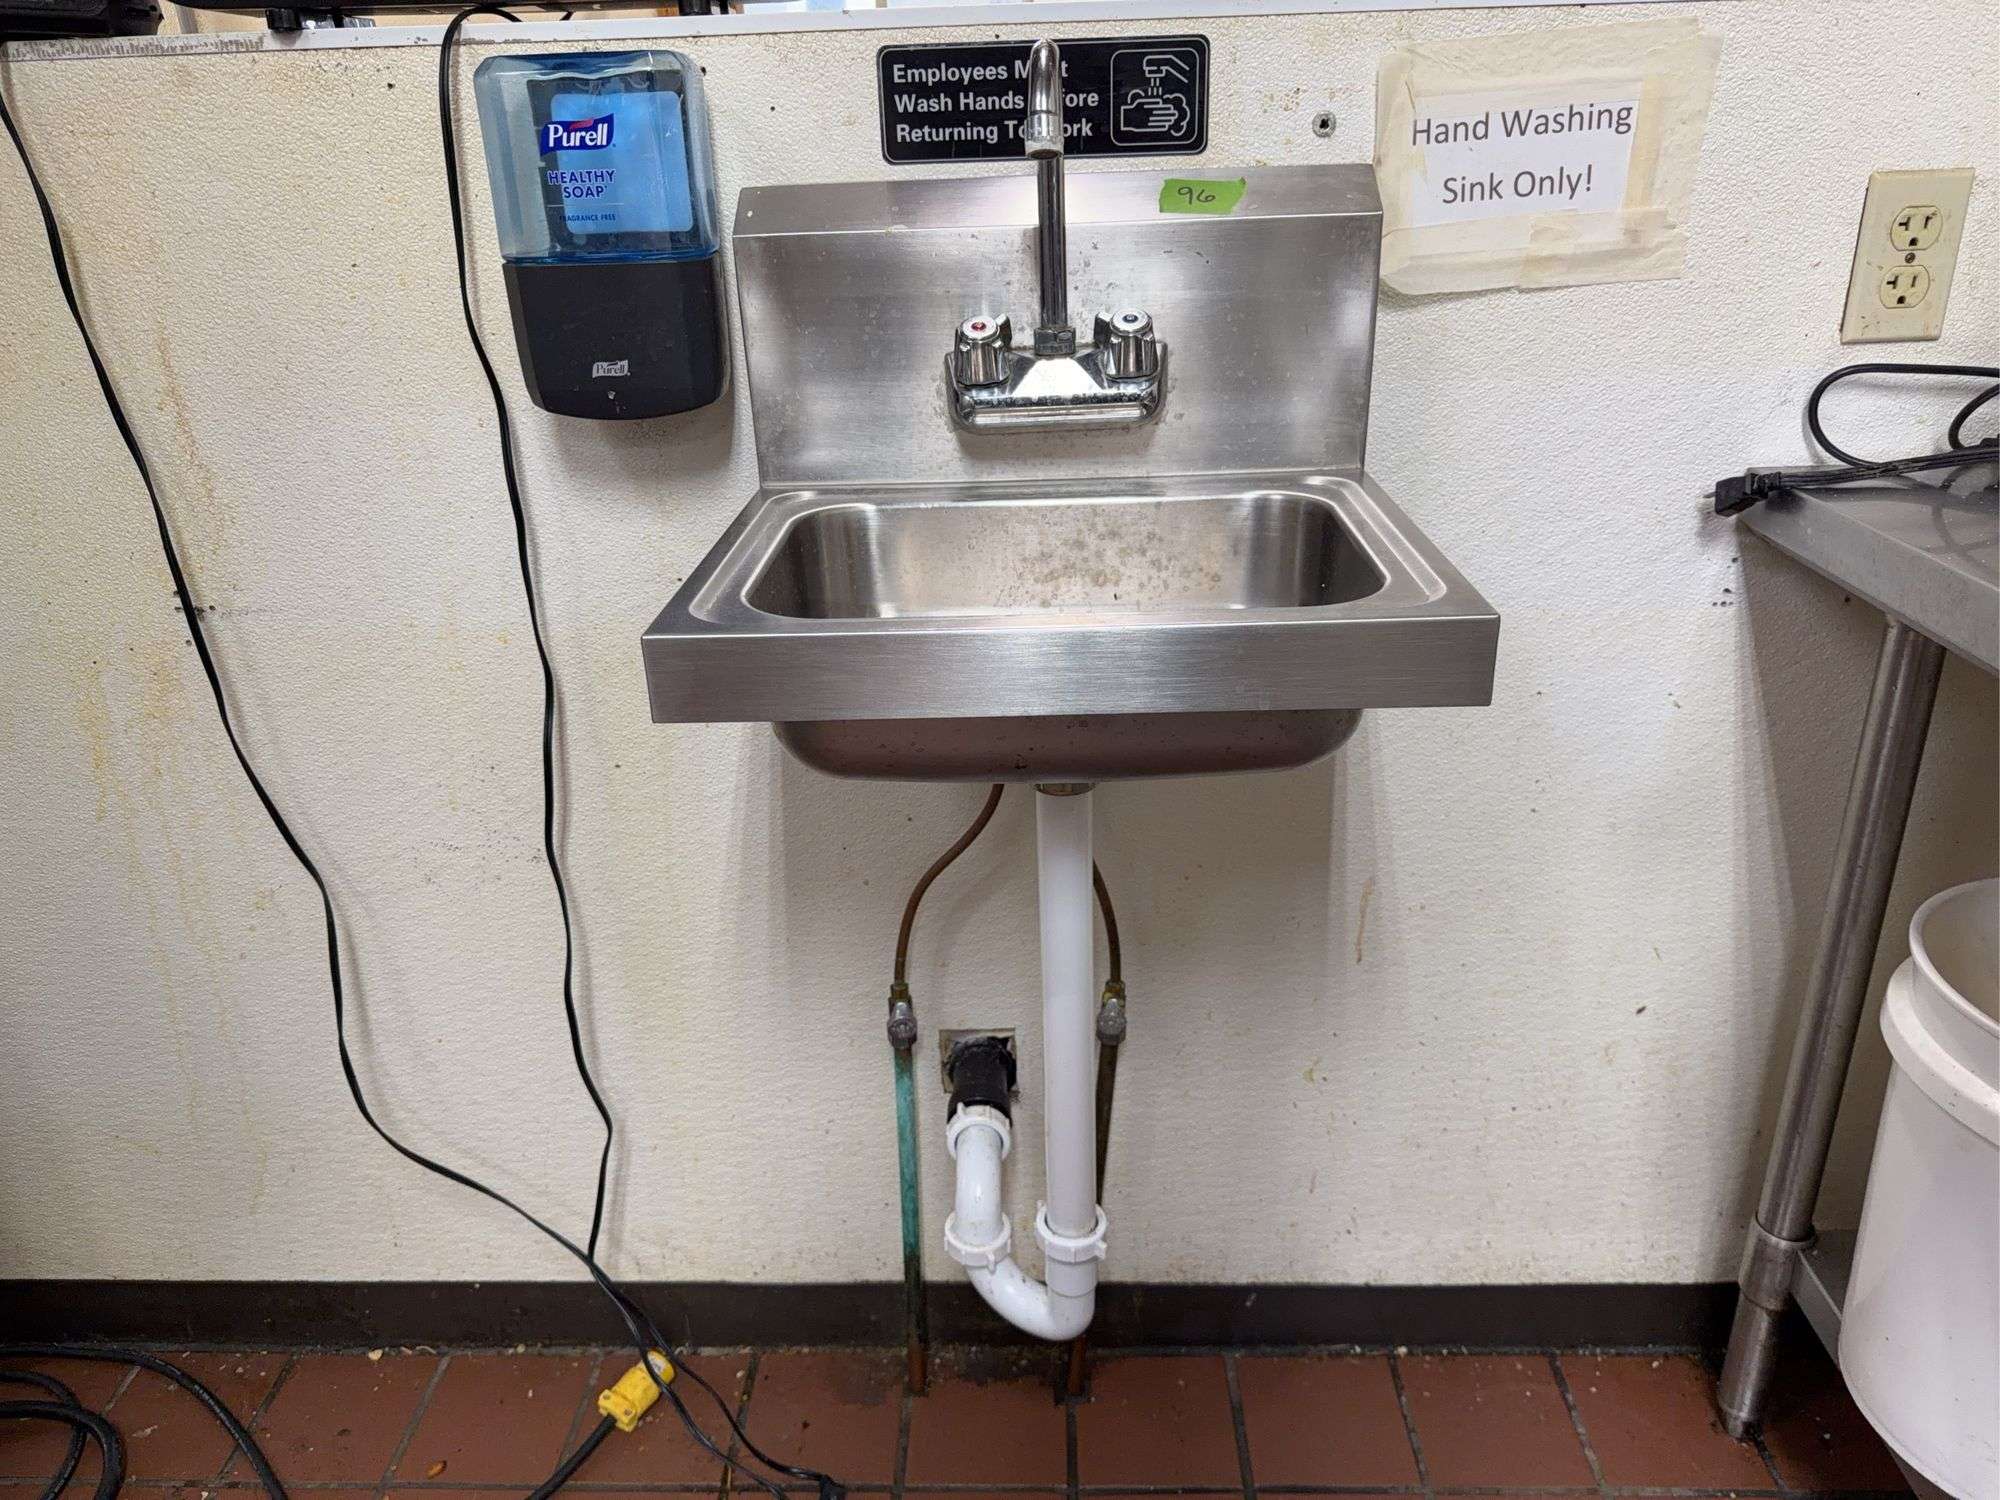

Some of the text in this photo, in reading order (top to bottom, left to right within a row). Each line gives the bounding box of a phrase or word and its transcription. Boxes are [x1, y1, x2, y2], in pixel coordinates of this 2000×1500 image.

[893, 60, 1069, 86] Employees Mt
[894, 93, 953, 113] Wash
[959, 90, 1025, 111] Hands
[547, 122, 609, 148] Purell
[896, 121, 999, 144] Returning
[1062, 118, 1094, 138] ork
[1411, 103, 1633, 146] Hand Washing
[547, 169, 616, 184] HEALTHY
[1442, 164, 1593, 204] Sink Only!
[563, 185, 605, 199] SOAP
[1177, 186, 1217, 205] 96
[596, 362, 625, 376] Purell
